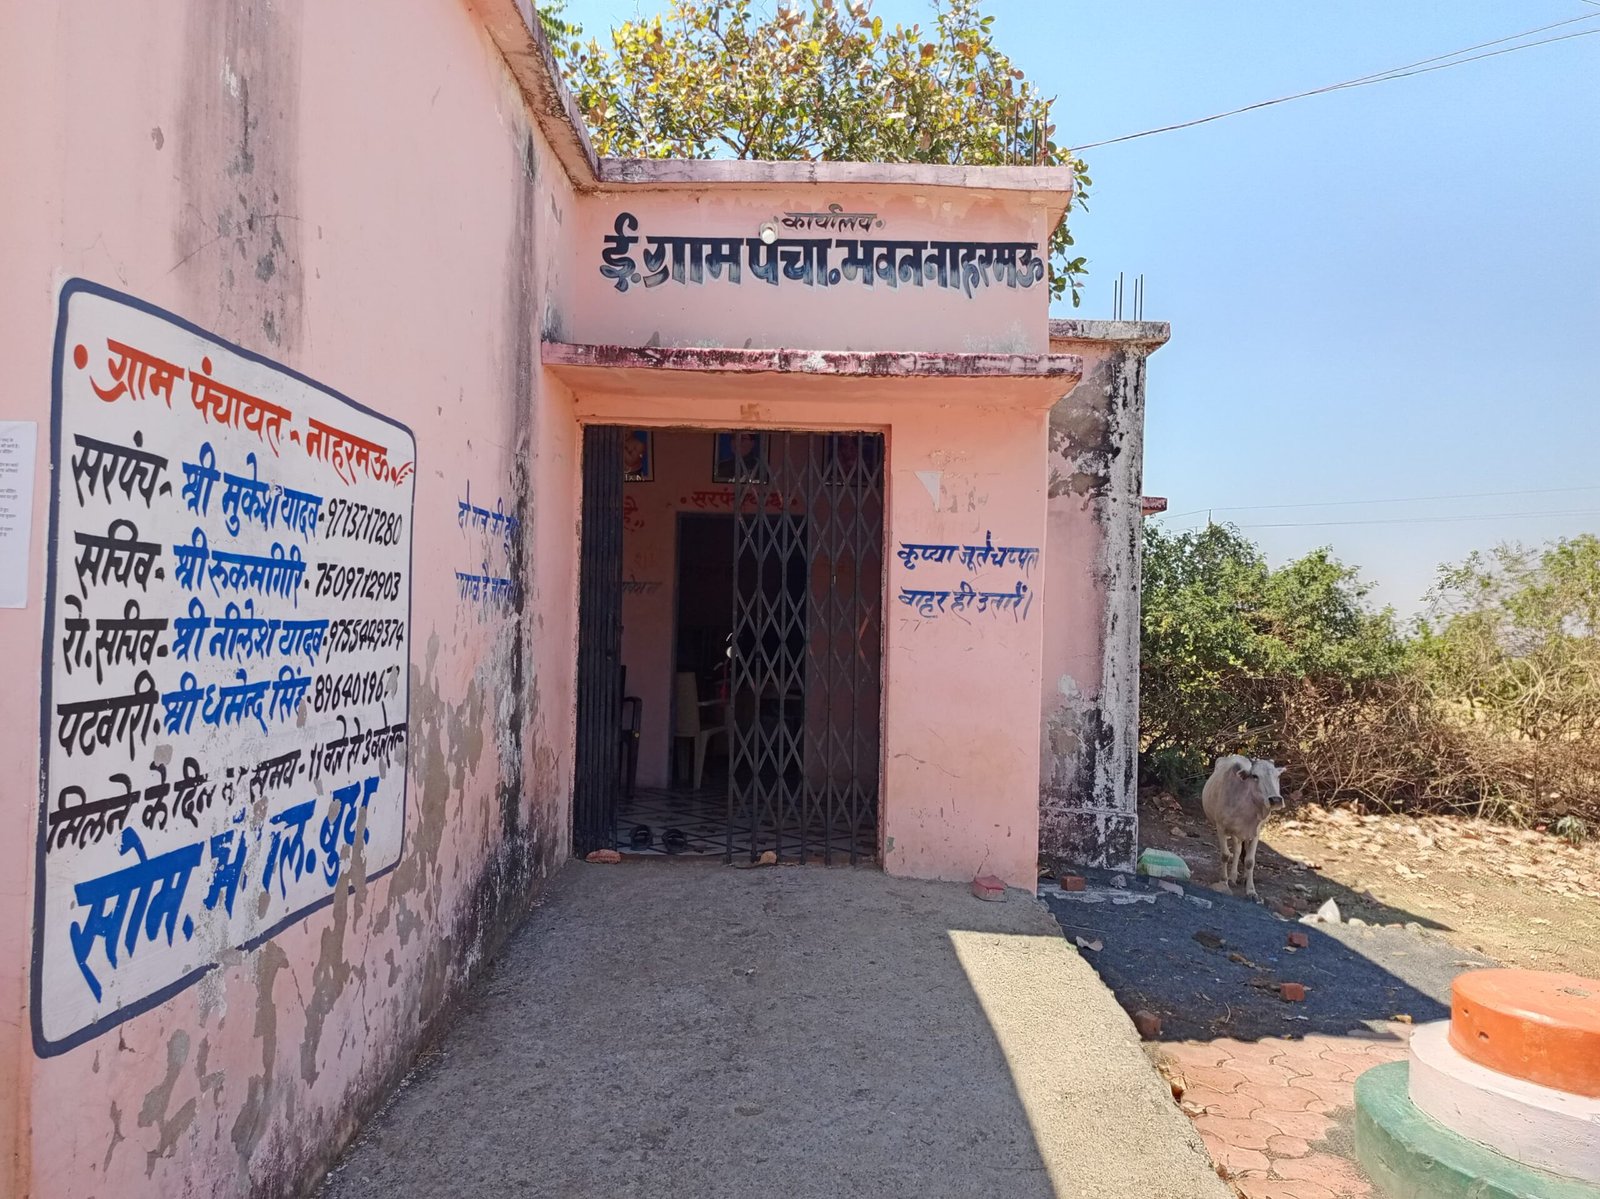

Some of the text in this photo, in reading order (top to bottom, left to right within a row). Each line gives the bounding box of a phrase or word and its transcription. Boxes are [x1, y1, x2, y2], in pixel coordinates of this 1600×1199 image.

[90, 337, 185, 410] ग्राम
[306, 417, 390, 486] नाहरमऊ
[182, 442, 221, 517] श्री
[221, 452, 282, 537] मुकेश
[326, 498, 403, 546] 9713717280
[173, 527, 209, 591] श्री
[315, 562, 402, 602] 7509712903
[172, 597, 211, 663] श्री
[950, 581, 977, 625] ही
[162, 671, 204, 736] श्री
[141, 761, 170, 831] के
